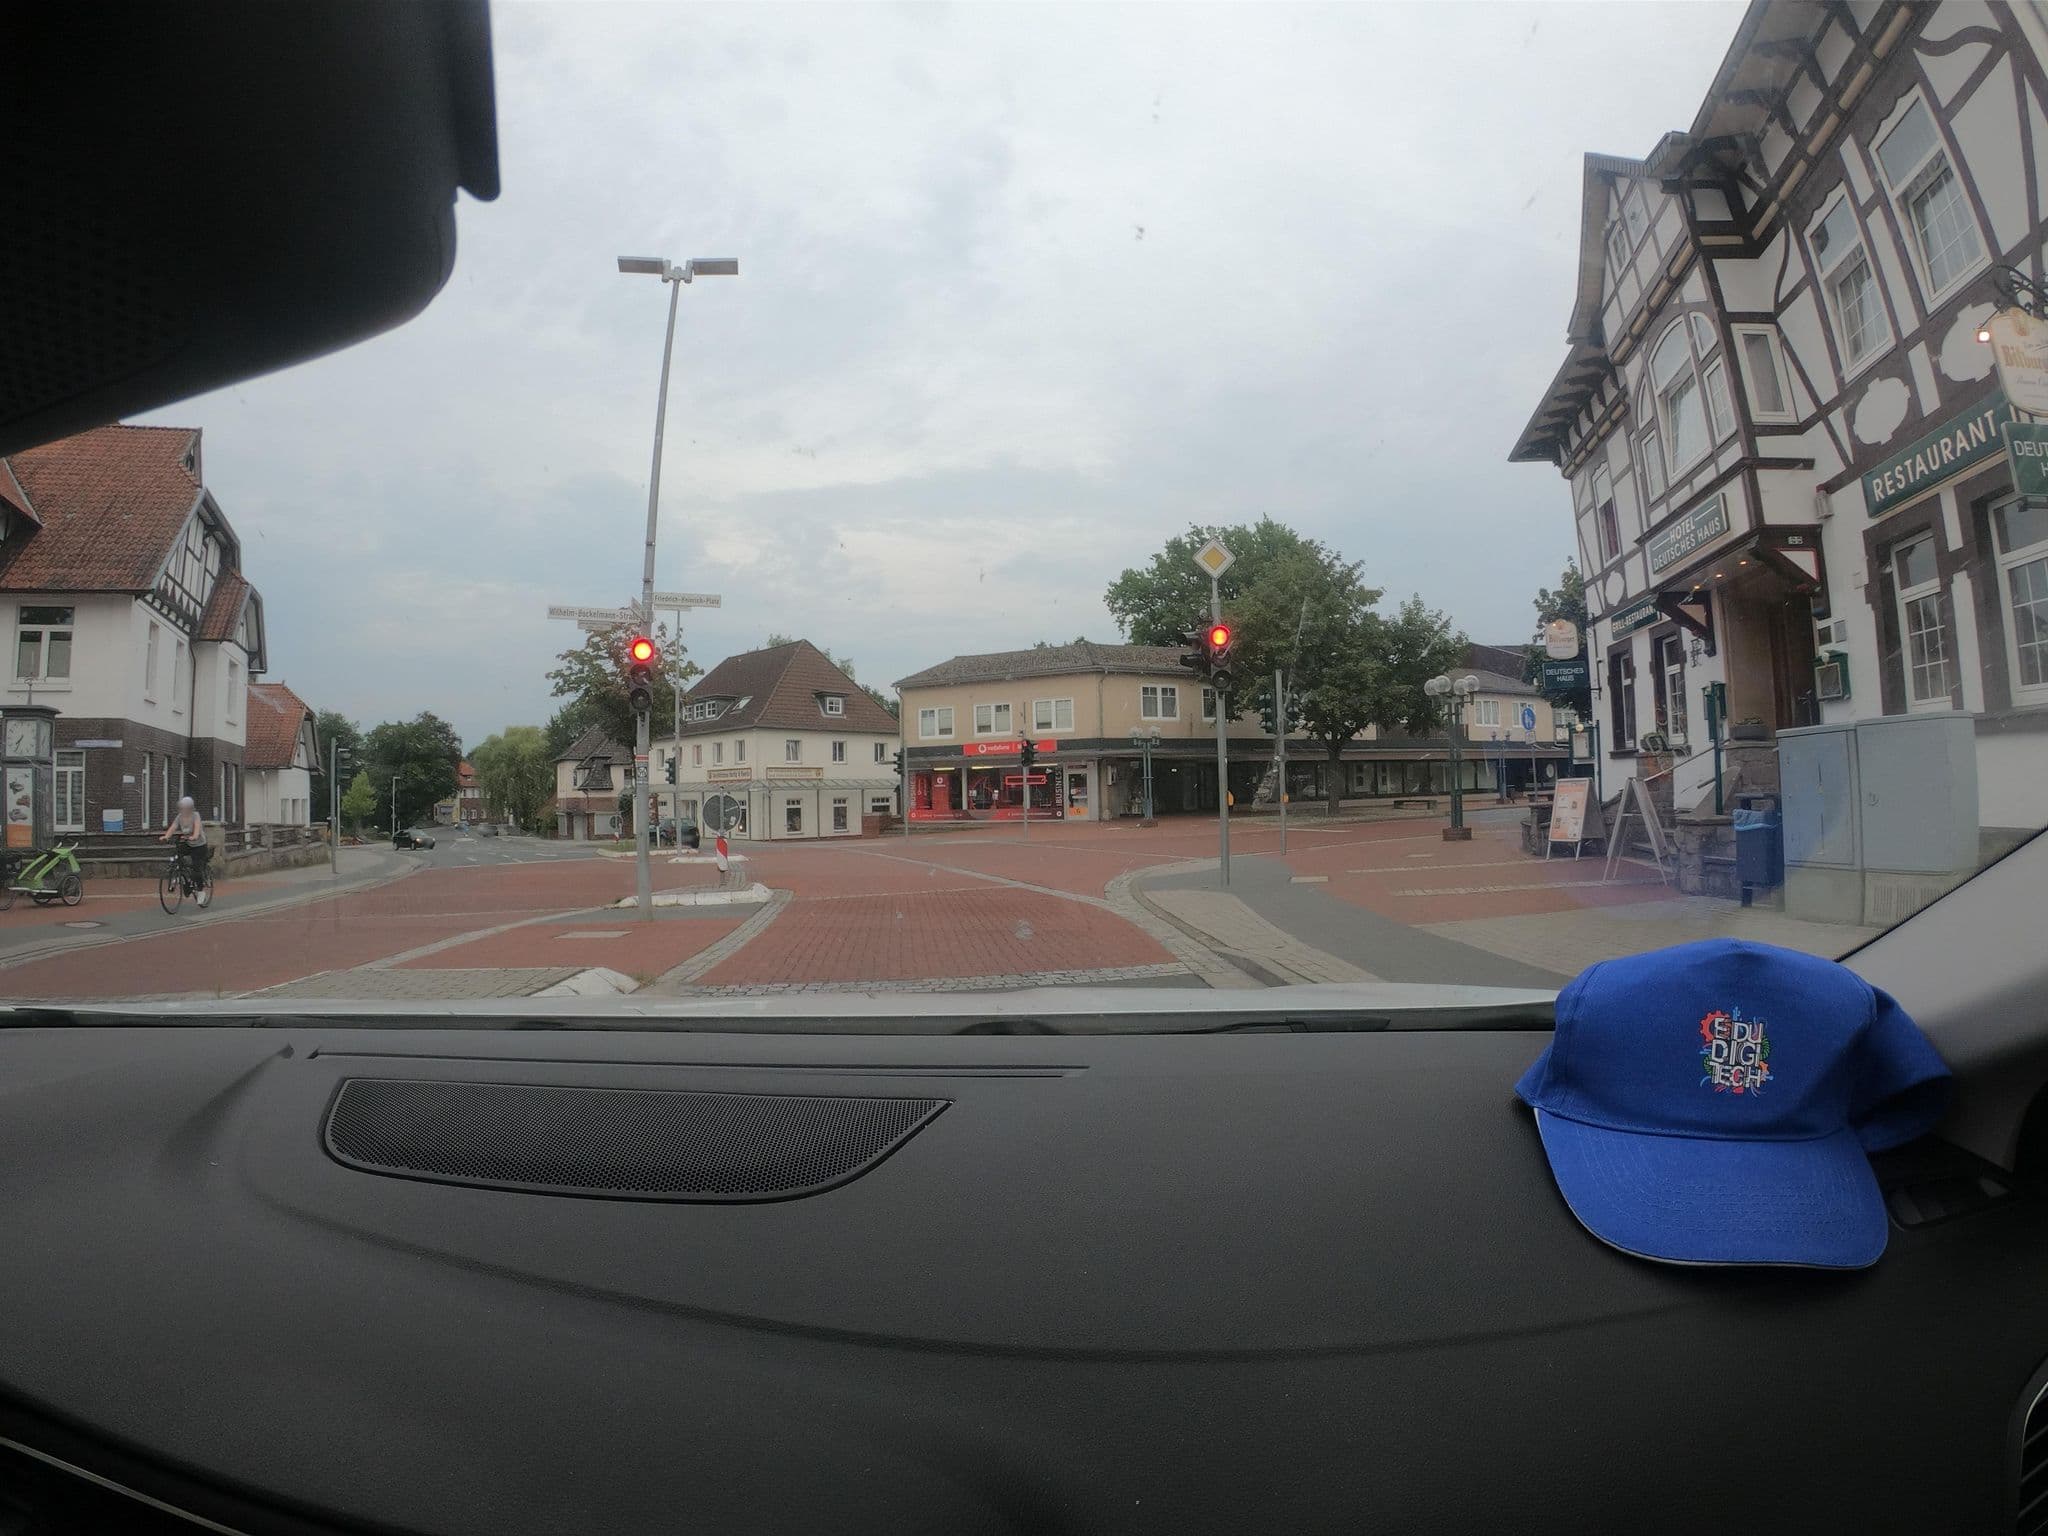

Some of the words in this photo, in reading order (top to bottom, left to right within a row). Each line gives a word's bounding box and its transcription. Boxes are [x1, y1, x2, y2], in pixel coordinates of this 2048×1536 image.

[1872, 409, 1997, 502] RESTAURANT
[1670, 515, 1696, 543] HOTEL
[1653, 533, 1696, 570] DEUTSCHES
[1696, 516, 1721, 543] HAUS
[549, 606, 642, 621] Wilhelm-Bockelmann-Straß
[1545, 667, 1584, 676] DEUTSCHES
[1714, 1017, 1764, 1043] EDU
[1711, 1039, 1761, 1067] DIGI
[1709, 1061, 1762, 1088] TECH
